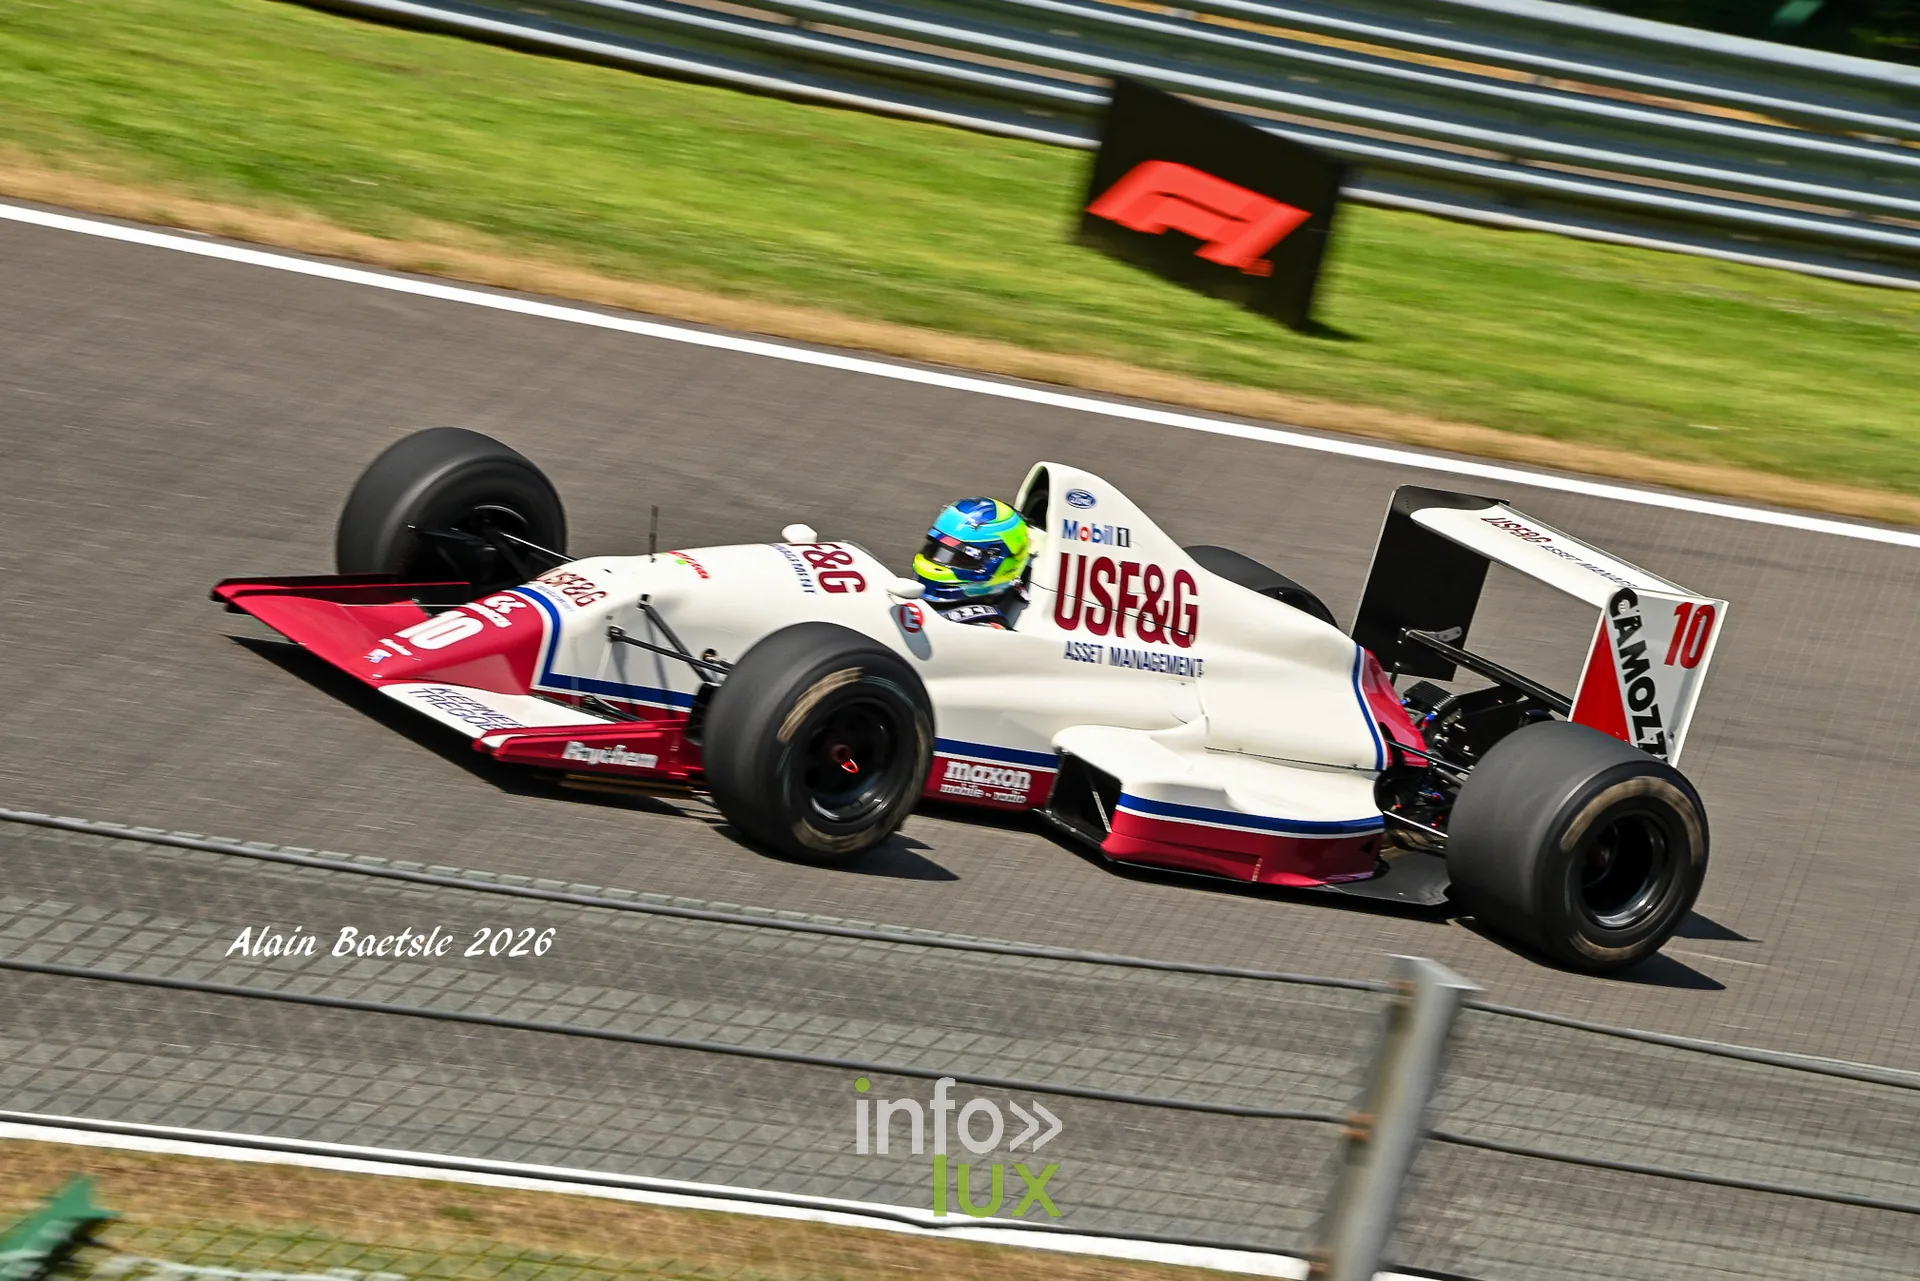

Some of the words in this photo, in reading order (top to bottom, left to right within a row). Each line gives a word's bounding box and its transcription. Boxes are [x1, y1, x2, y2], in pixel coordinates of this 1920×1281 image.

[1062, 518, 1114, 546] Mobil
[1117, 527, 1129, 547] 1
[1054, 551, 1198, 649] USF&G
[394, 610, 485, 651] 10
[1664, 601, 1716, 670] 10
[1063, 640, 1104, 665] ASSET
[1108, 646, 1205, 679] MANAGEMENT
[1609, 587, 1669, 764] CAMOZZ
[944, 760, 1032, 790] maxon
